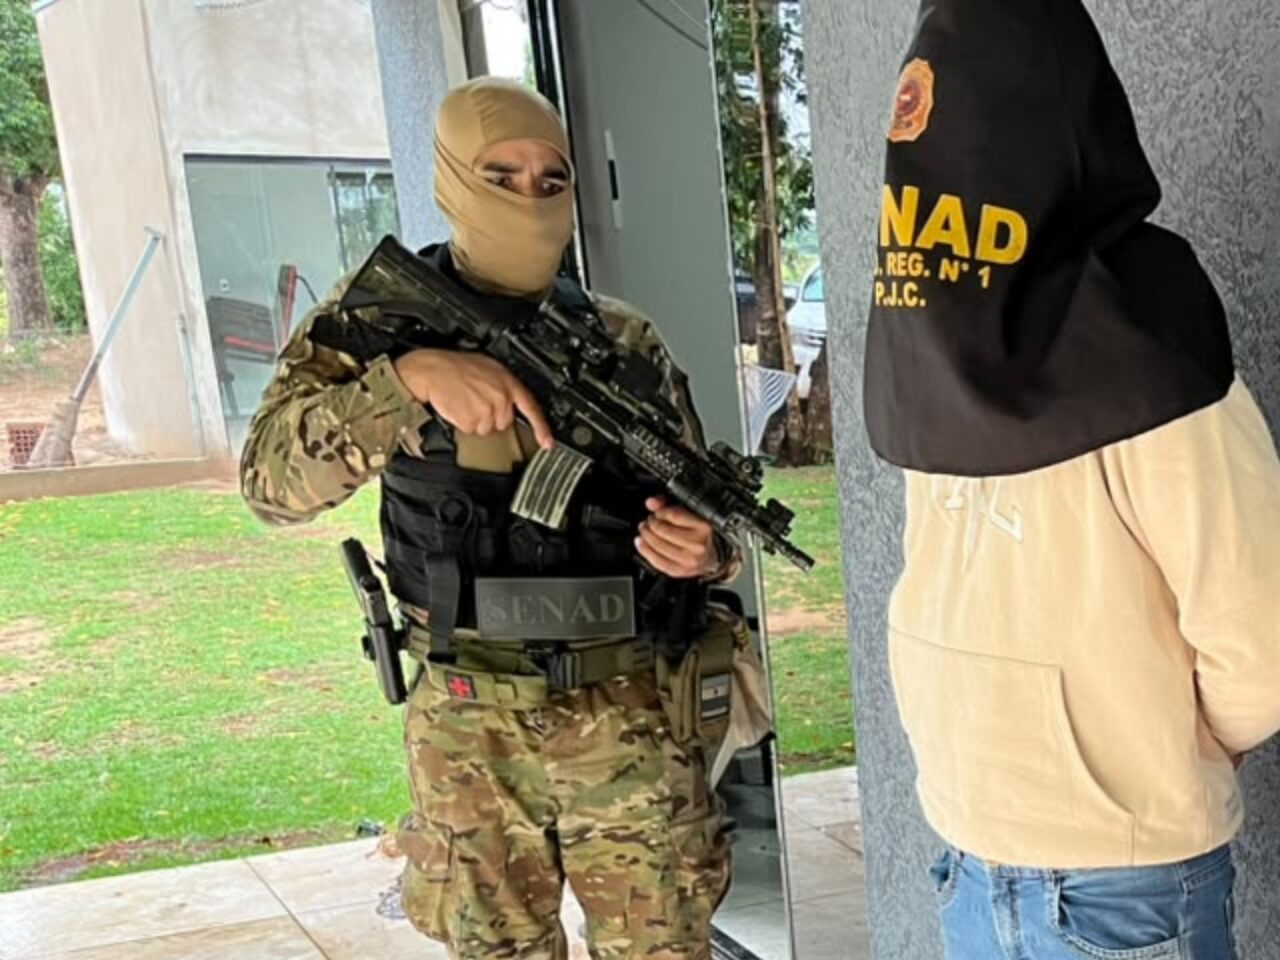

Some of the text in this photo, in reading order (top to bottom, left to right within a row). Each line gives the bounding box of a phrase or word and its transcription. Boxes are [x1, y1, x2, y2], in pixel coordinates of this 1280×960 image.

[886, 252, 930, 277] REG.
[978, 266, 990, 288] 1
[484, 593, 624, 626] SENAD
